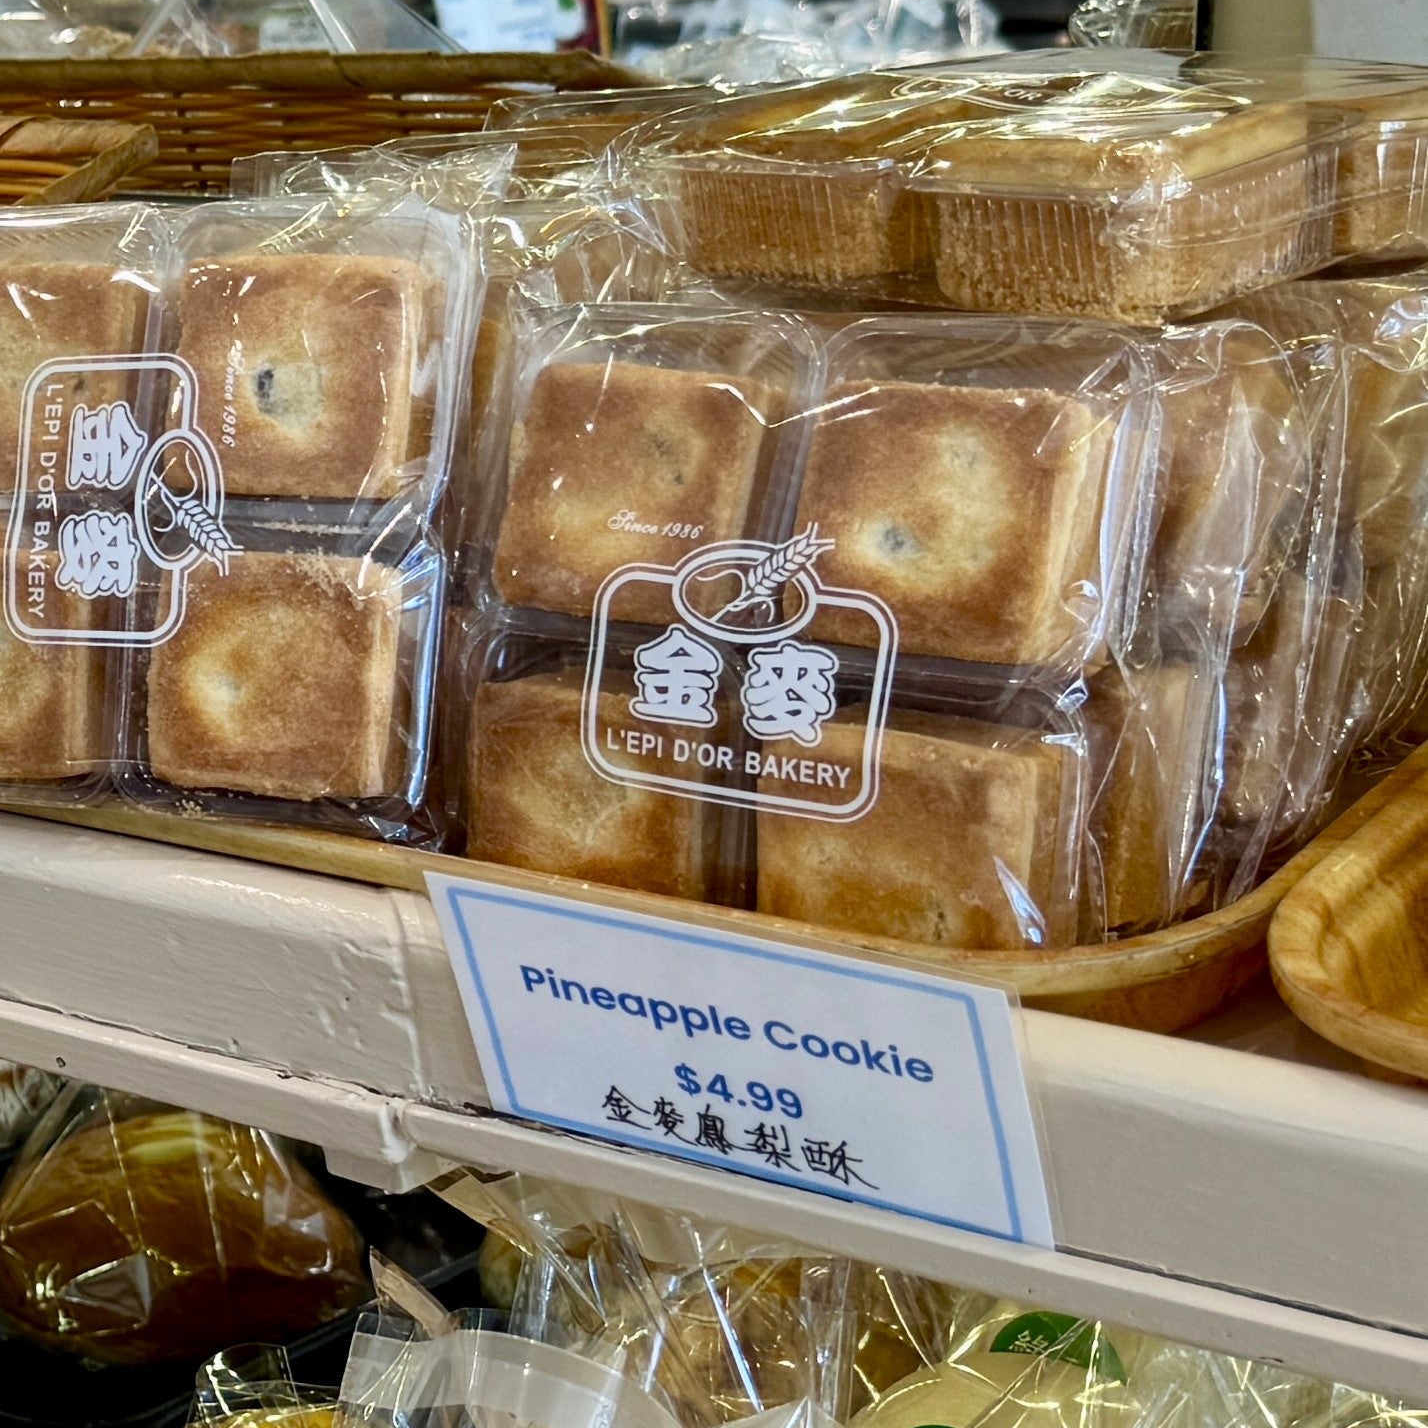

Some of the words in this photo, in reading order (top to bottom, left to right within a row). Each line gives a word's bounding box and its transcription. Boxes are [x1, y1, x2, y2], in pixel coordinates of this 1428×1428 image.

[44, 382, 66, 442] L'EPI
[34, 450, 57, 511] D'OR
[660, 519, 705, 541] 1986
[27, 519, 53, 620] BAKERY
[630, 625, 840, 748] 金麥
[604, 726, 665, 762] L'EPI
[672, 737, 735, 773] D'OR
[744, 749, 852, 791] BAKERY
[518, 963, 753, 1042] Pineapple
[763, 1018, 936, 1085] Cookie
[673, 1062, 804, 1121] $4.99
